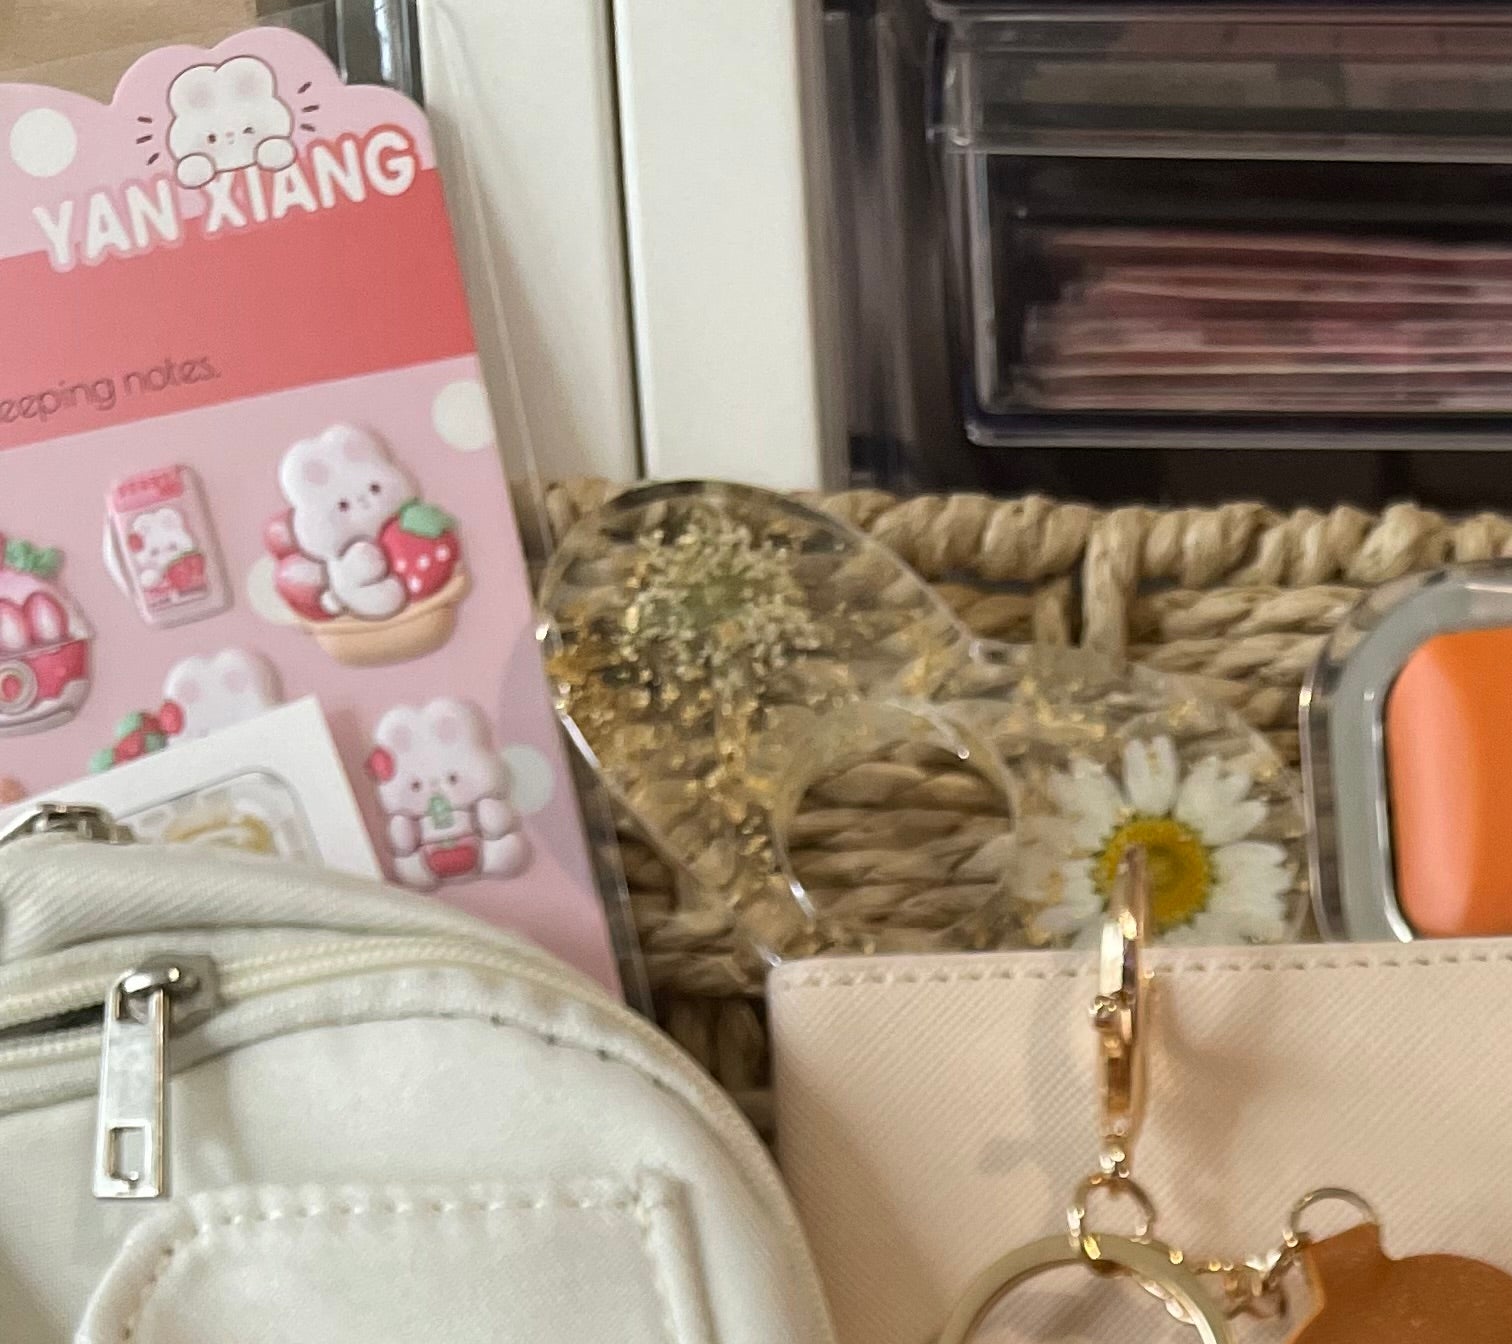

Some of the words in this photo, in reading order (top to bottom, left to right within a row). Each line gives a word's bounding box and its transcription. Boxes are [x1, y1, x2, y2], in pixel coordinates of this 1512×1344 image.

[32, 179, 180, 264] YAN
[206, 132, 416, 233] XIANG
[0, 380, 117, 422] eeping
